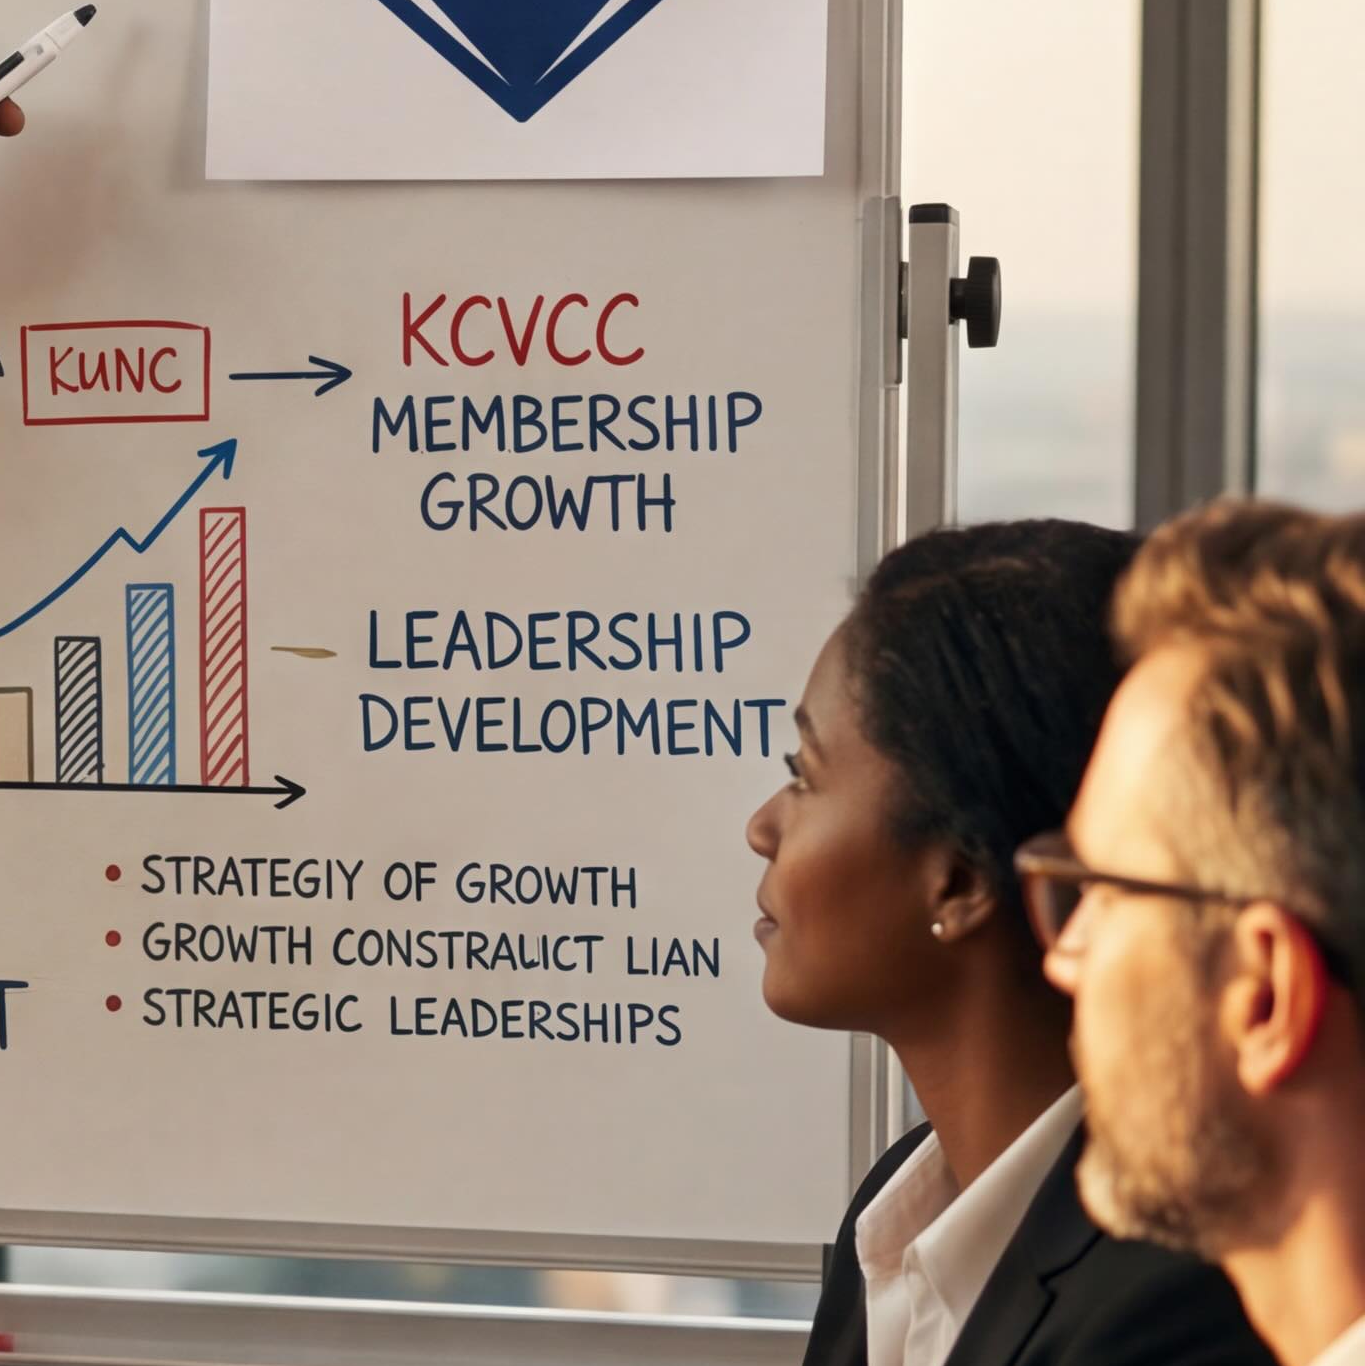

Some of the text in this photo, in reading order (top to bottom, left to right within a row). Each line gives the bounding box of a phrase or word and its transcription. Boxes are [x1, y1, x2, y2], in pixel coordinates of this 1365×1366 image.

[402, 292, 645, 367] KCVCC
[372, 391, 763, 454] MEMBERSHIP
[420, 472, 676, 533] GROWTH
[369, 609, 751, 673] LEADERSHIP
[359, 693, 787, 757] DEVELOPMENT
[383, 861, 438, 902] OF
[455, 862, 637, 909] GROWTH
[142, 921, 312, 966] GROWTH
[626, 935, 720, 978] LIAN
[142, 987, 682, 1047] STRATEGIC LEADERSHIPS
